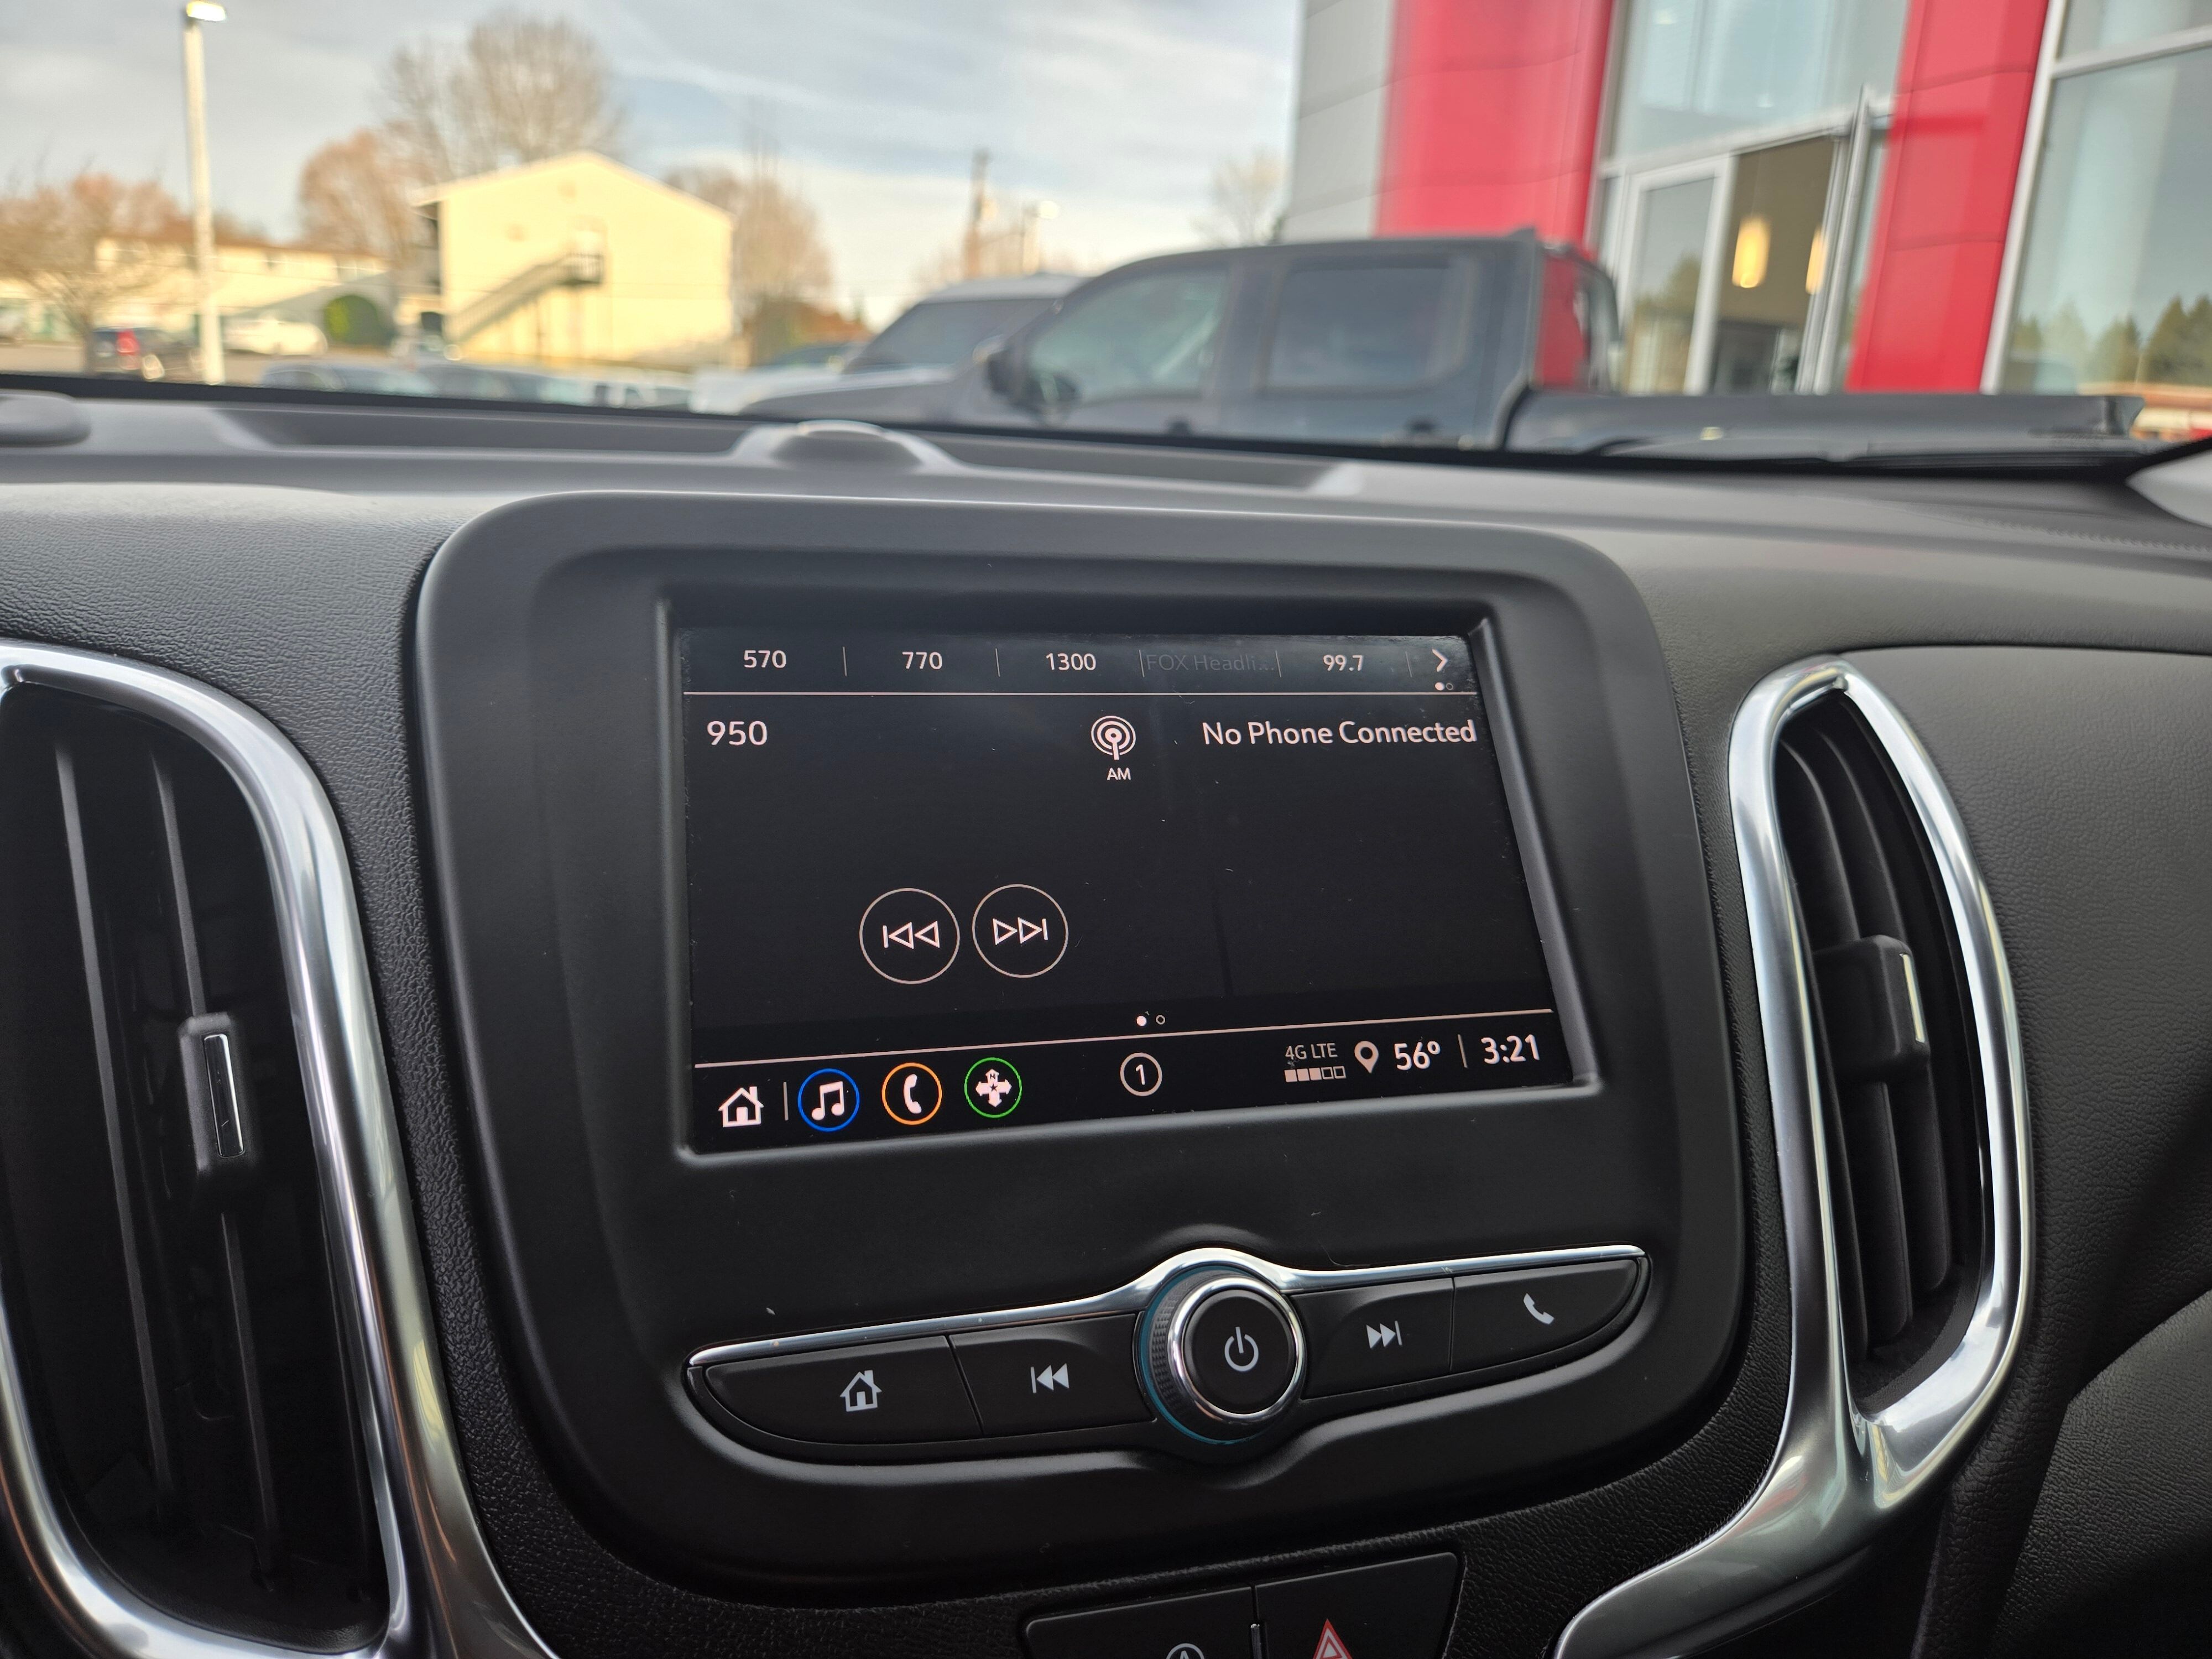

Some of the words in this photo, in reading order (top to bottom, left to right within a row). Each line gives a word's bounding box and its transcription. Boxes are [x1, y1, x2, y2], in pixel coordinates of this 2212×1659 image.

[744, 650, 787, 668] 570
[902, 651, 943, 670] 770
[1045, 653, 1097, 670] 1300
[1146, 654, 1189, 671] FOX
[1323, 654, 1364, 671] 99.7
[707, 721, 768, 746] 950
[1202, 722, 1241, 745] No
[1248, 721, 1333, 744] Phone
[1339, 718, 1478, 744] Connected
[1107, 767, 1132, 781] AM
[1285, 1045, 1307, 1060] 4G
[1311, 1042, 1338, 1059] LTE
[1480, 1034, 1540, 1065] 3:21
[1135, 1063, 1146, 1086] 1
